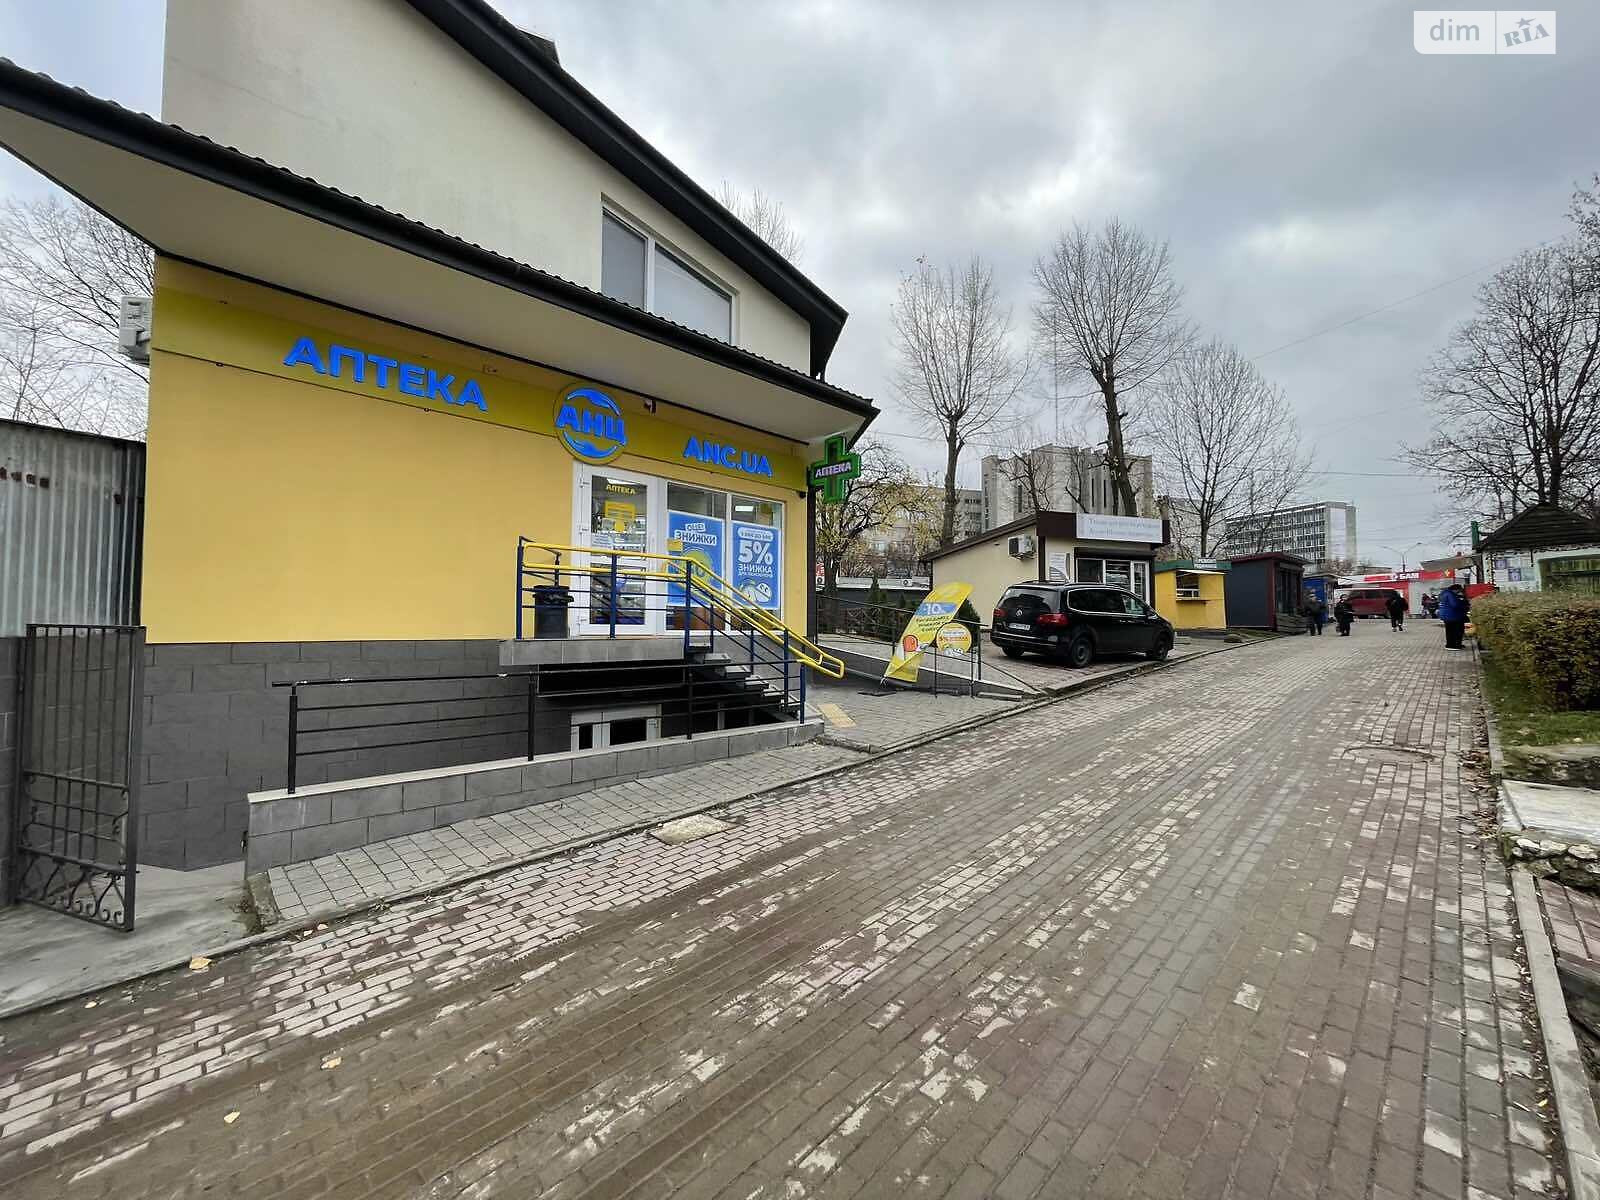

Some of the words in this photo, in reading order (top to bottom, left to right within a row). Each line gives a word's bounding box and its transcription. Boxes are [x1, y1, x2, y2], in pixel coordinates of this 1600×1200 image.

[283, 335, 489, 412] АПТЕКА
[556, 401, 627, 446] АНЦ
[683, 436, 774, 478] ANC.UA
[815, 461, 852, 478] АПТЕКА
[675, 530, 716, 545] ЗНИЖКИ
[738, 540, 773, 565] 5%
